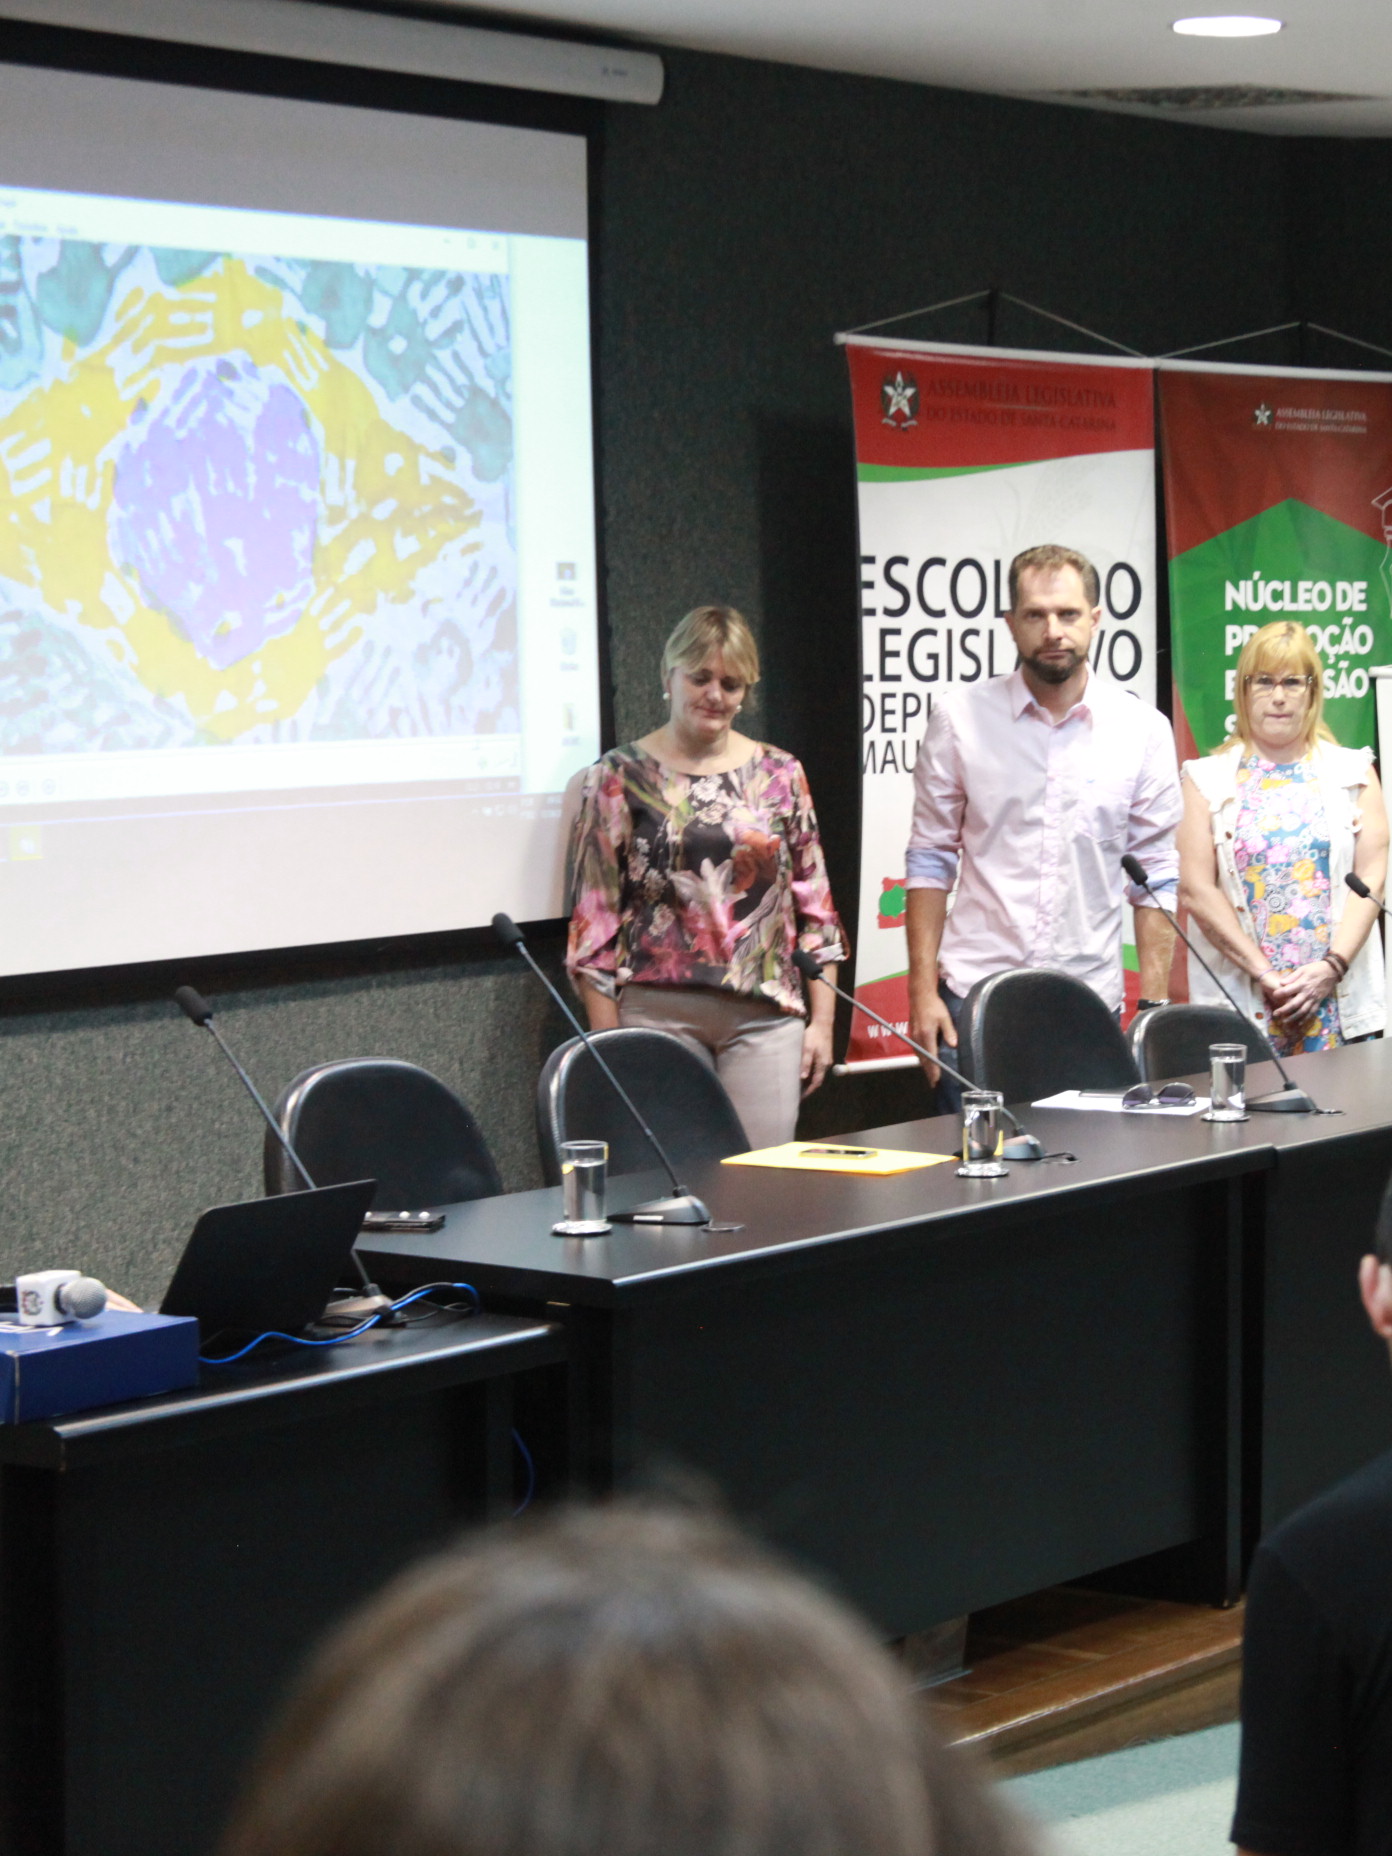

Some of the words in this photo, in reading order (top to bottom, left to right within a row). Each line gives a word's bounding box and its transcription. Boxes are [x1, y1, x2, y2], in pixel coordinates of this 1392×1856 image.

[861, 555, 1008, 619] ESCOL
[1225, 571, 1333, 611] NÚCLEO
[1335, 581, 1367, 611] DE
